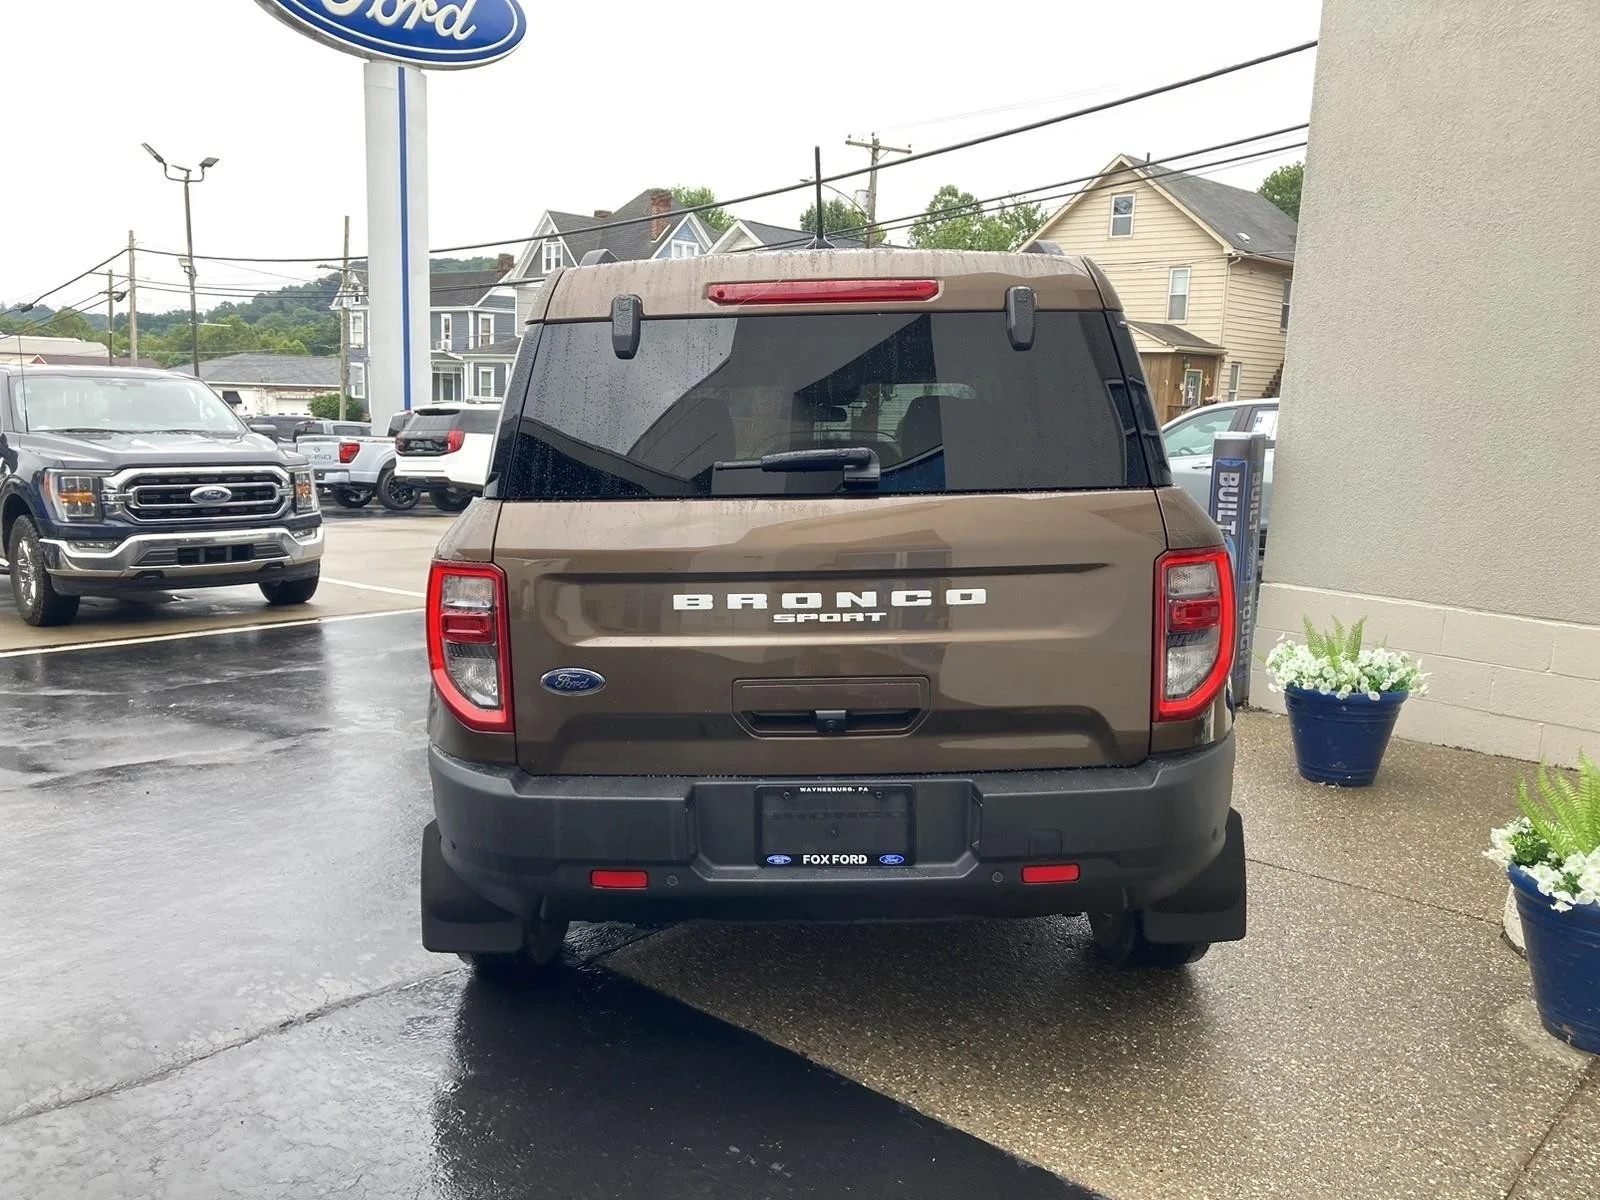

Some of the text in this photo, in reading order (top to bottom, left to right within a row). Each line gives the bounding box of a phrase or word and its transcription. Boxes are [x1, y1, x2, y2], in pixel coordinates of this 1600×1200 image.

[321, 0, 477, 41] ord
[1217, 472, 1240, 535] BUILT
[1249, 472, 1261, 533] BUILT
[673, 588, 987, 610] BRONCO
[773, 612, 887, 623] SPORT
[555, 674, 590, 689] Ford
[802, 854, 831, 865] FOX
[831, 854, 868, 865] FORD
